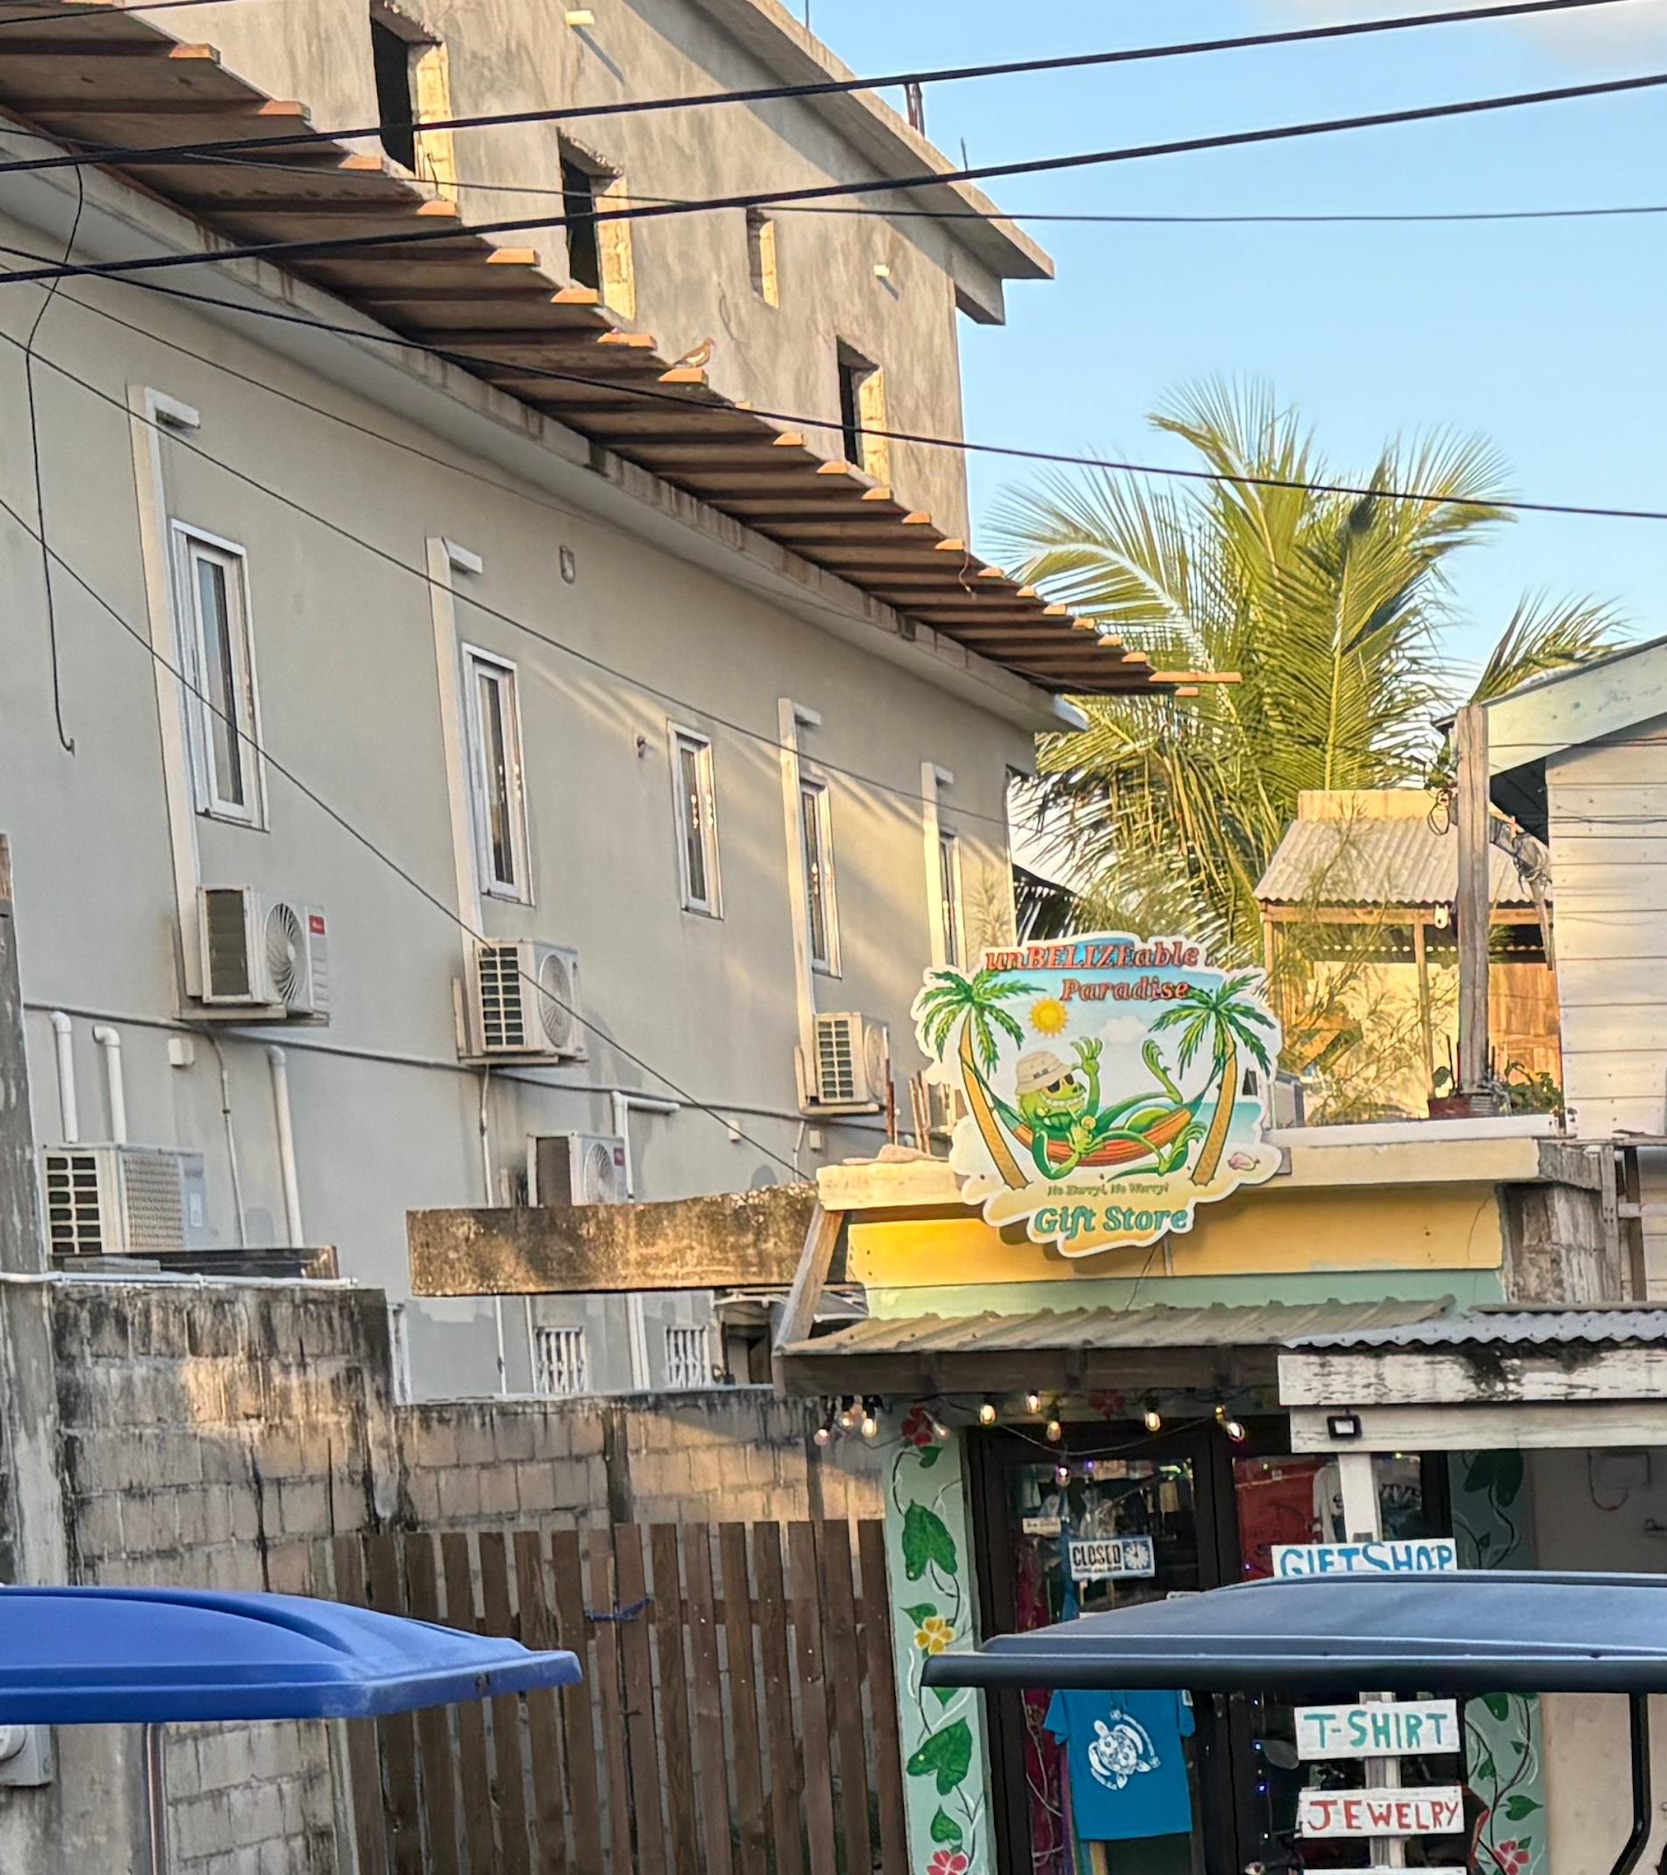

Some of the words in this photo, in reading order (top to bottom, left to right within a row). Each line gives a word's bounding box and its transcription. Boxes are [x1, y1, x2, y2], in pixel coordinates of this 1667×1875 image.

[985, 941, 1200, 971] unBELIZEable
[1060, 975, 1189, 1001] Paradise
[1035, 1206, 1096, 1240] Gift
[1103, 1206, 1188, 1231] Store
[1072, 1544, 1121, 1567] CLOSED
[1303, 1709, 1447, 1749] T-SHIRT
[1307, 1799, 1459, 1831] JEWELRY
